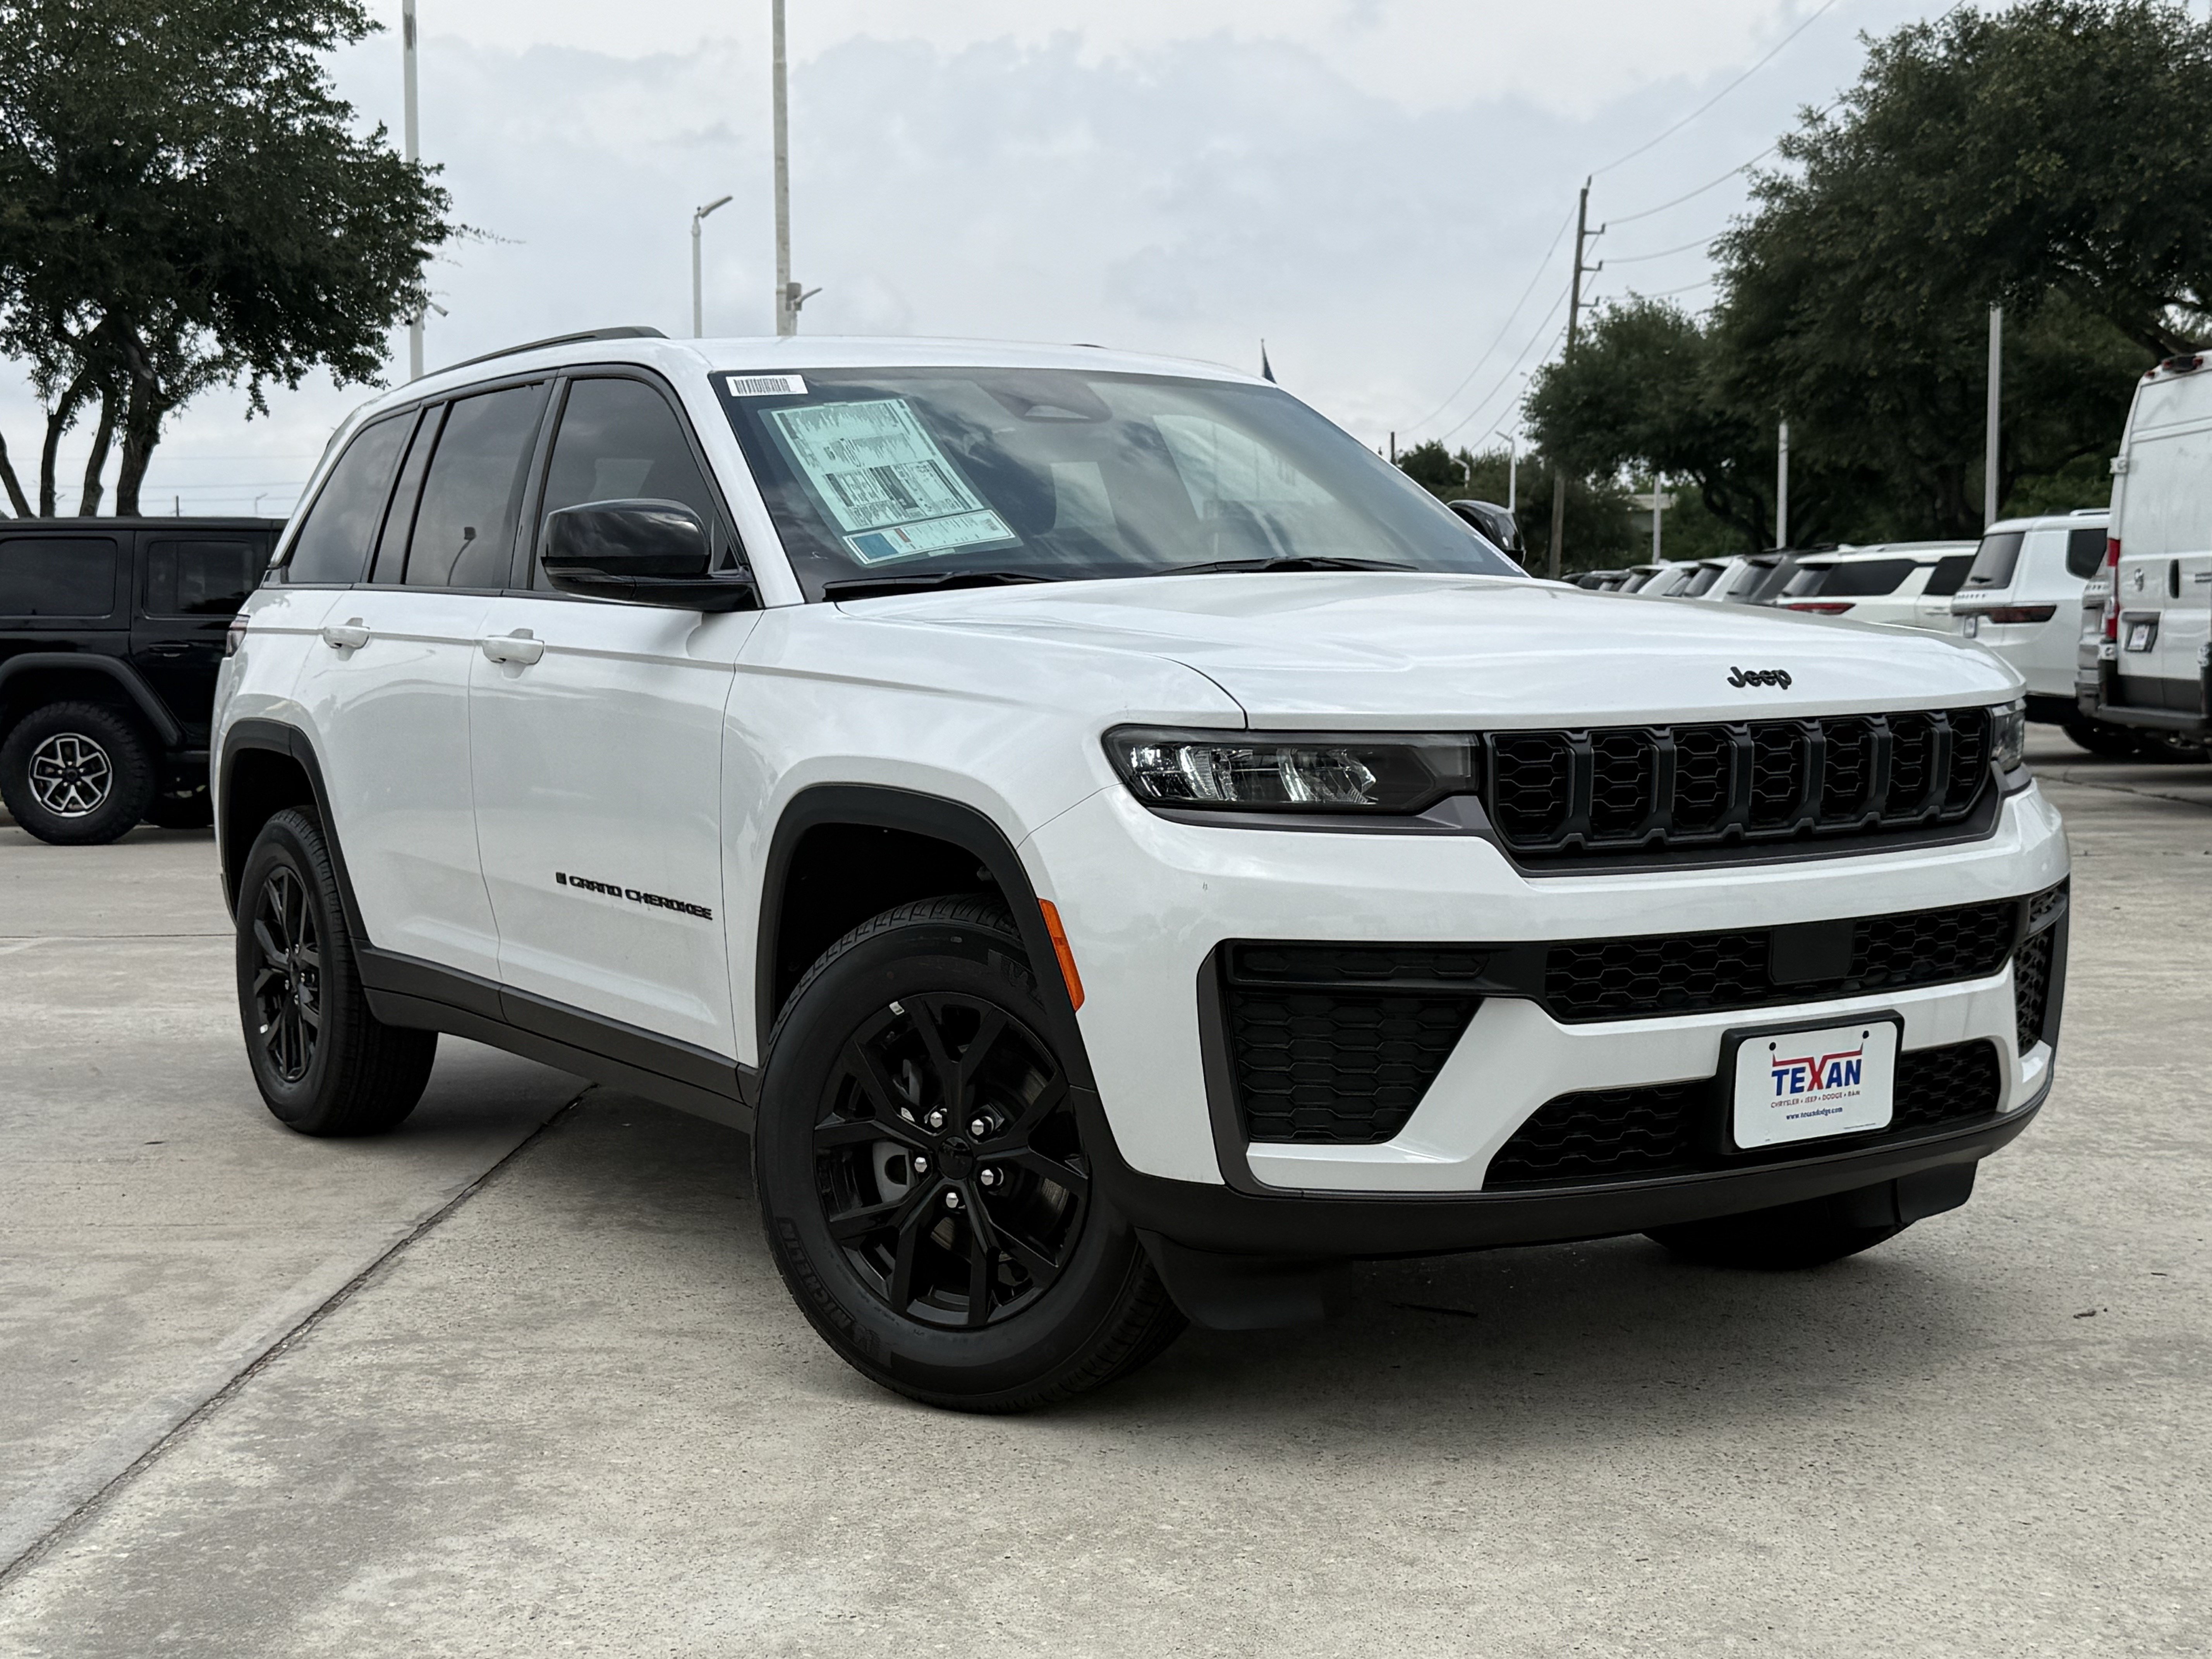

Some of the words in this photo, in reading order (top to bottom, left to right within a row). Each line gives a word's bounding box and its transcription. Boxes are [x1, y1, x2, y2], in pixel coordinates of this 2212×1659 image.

[1727, 666, 1792, 690] Jeep
[569, 876, 622, 898] GRAND
[625, 889, 713, 921] CHEROKEE
[1771, 1055, 1862, 1096] TEXAN
[1771, 1098, 1799, 1108] CHRYSLER
[1822, 1092, 1842, 1101] DODGE
